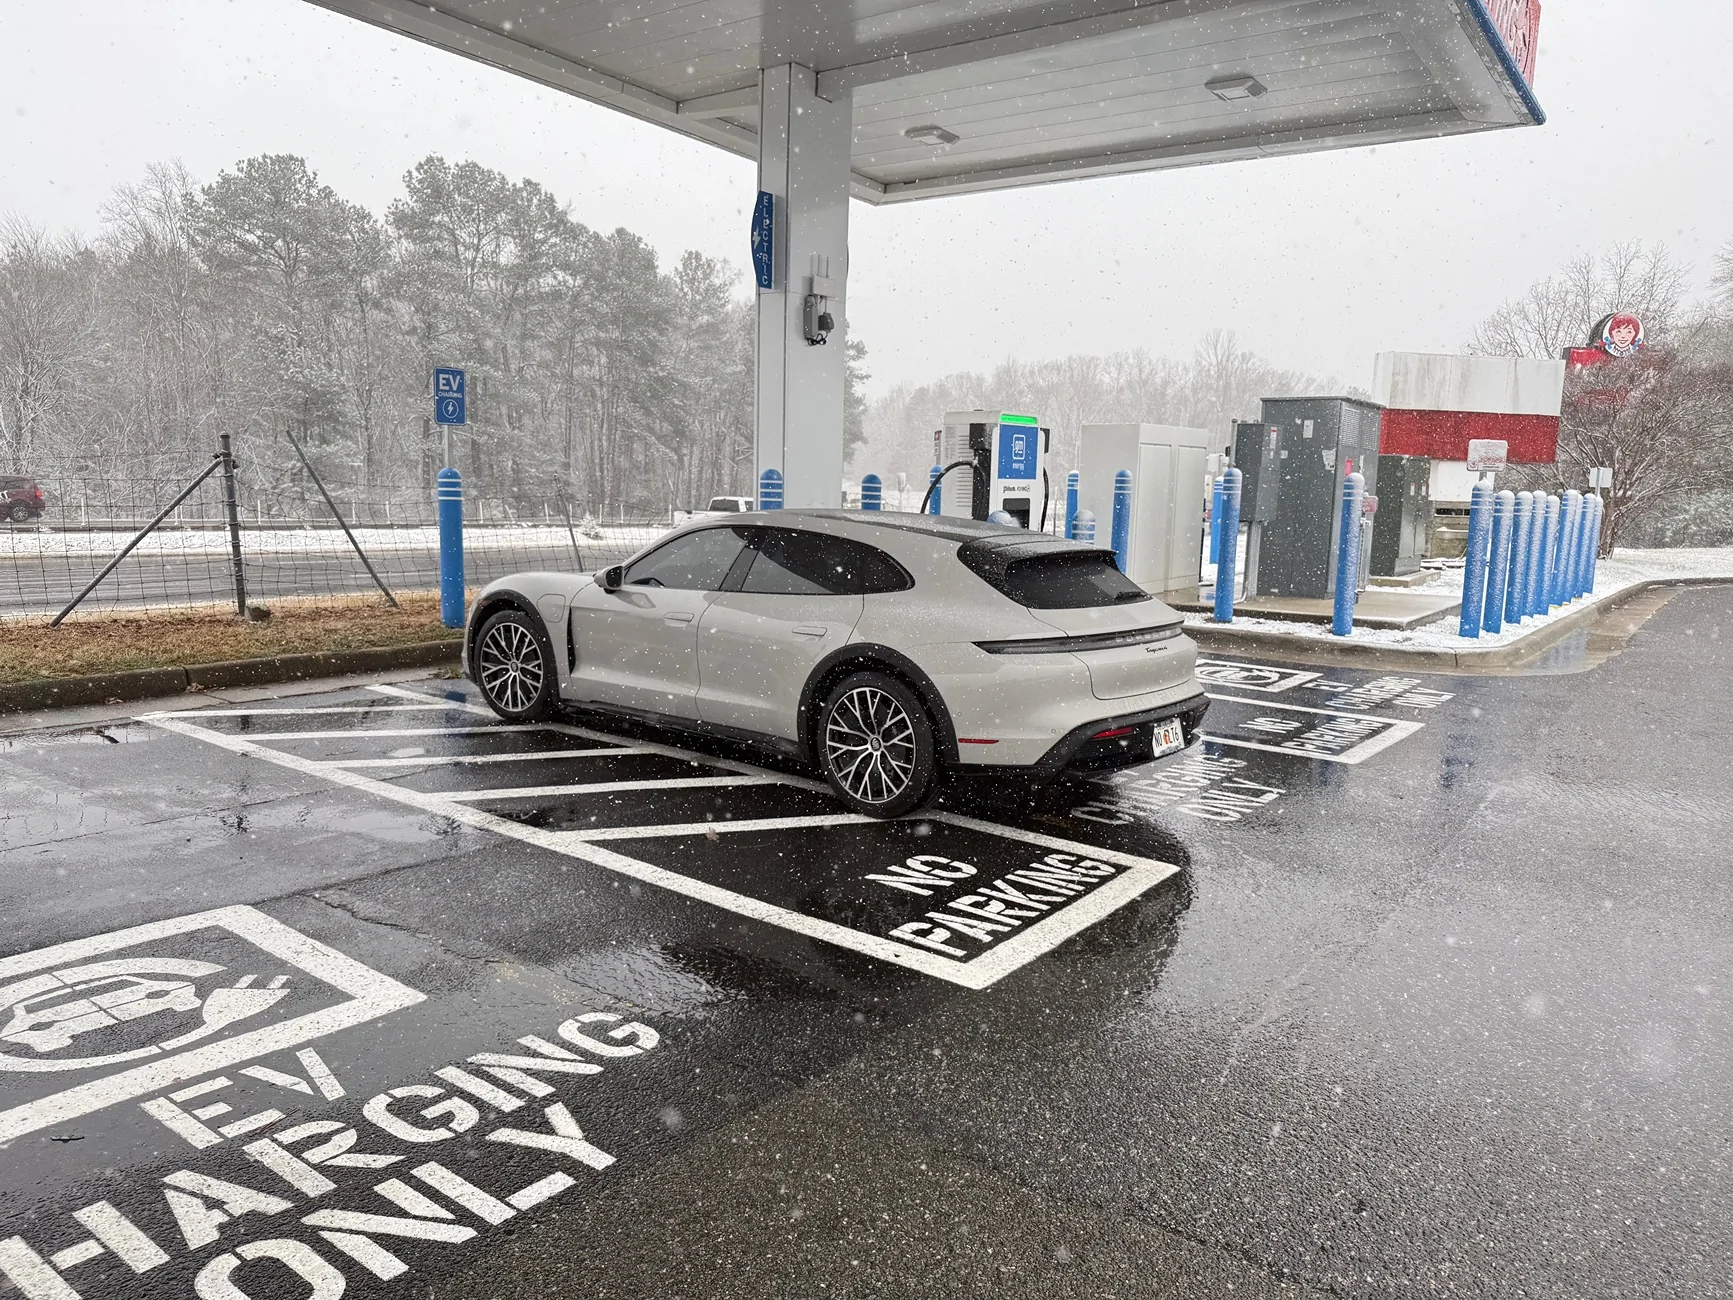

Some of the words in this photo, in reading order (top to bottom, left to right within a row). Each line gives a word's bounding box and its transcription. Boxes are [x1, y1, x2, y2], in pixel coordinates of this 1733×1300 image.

[762, 195, 770, 285] ELECTRIC
[439, 374, 460, 391] EV
[1238, 717, 1302, 734] NO
[1392, 687, 1456, 709] ONLY
[1281, 718, 1384, 754] PARKING
[1070, 755, 1247, 825] CHARGING
[1176, 778, 1286, 821] ONLY
[864, 855, 977, 896] NO
[888, 854, 1116, 957] PARKING
[139, 1047, 347, 1150] EV
[0, 1012, 660, 1300] HARGING
[194, 1102, 617, 1300] ONLY
